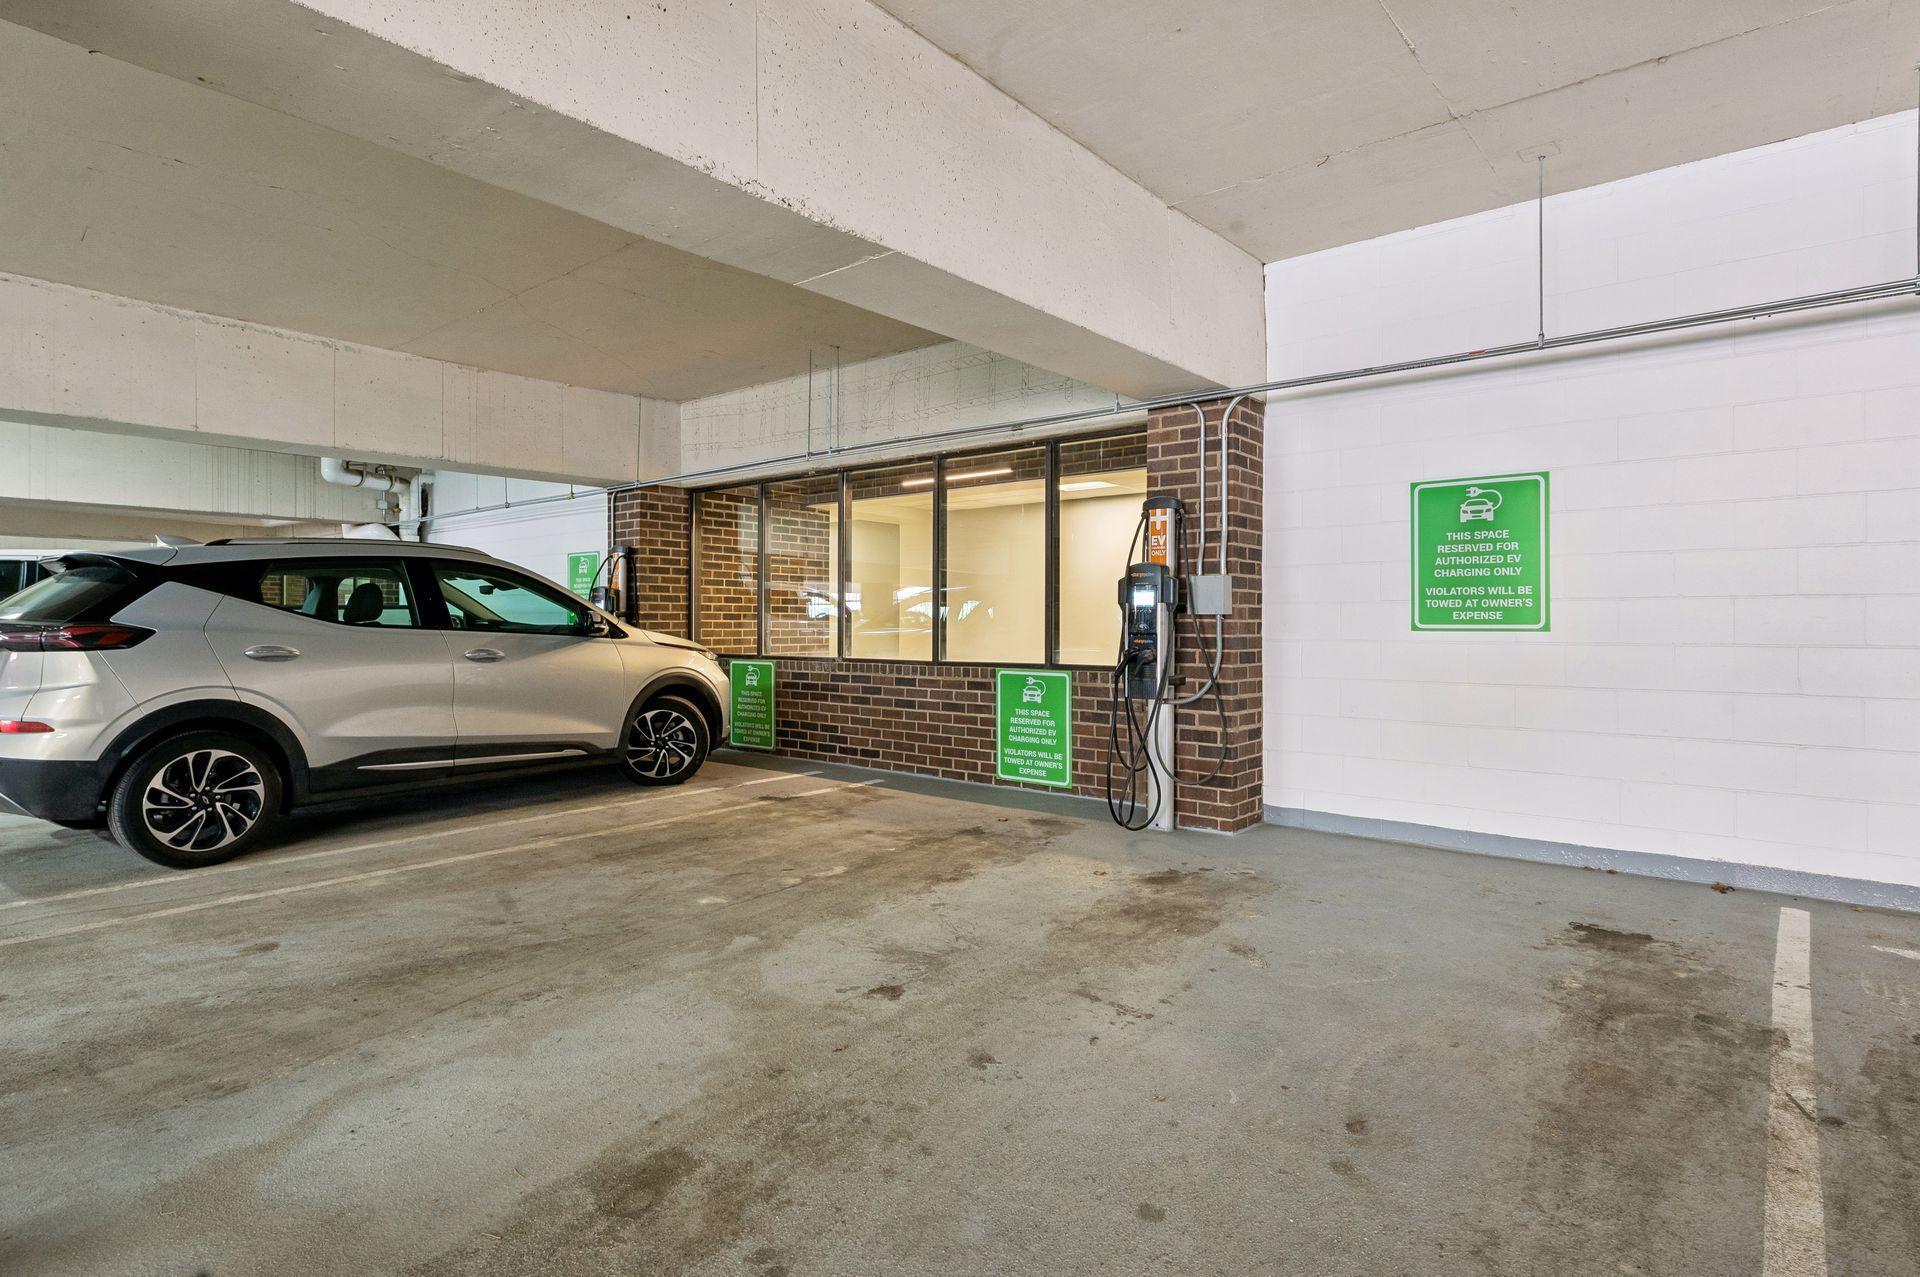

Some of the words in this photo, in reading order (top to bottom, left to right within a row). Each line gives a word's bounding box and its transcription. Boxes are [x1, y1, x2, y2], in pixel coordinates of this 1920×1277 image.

[1446, 531, 1471, 540] THIS
[1474, 530, 1510, 540] SPACE
[1152, 535, 1166, 546] EV
[1438, 542, 1492, 553] RESERVED
[1497, 542, 1519, 550] FOR
[1436, 554, 1504, 566] AUTHORIZED
[1507, 554, 1522, 562] EV
[1434, 568, 1490, 578] CHARGING
[1494, 567, 1522, 576] ONLY
[1426, 586, 1485, 596] VIOLATORS
[1488, 586, 1514, 594] WILL
[1518, 586, 1532, 594] BE
[1426, 599, 1462, 608] TOWED
[1466, 599, 1478, 608] AT
[1482, 598, 1533, 608] OWNER'S
[1452, 611, 1502, 620] EXPENSE
[1030, 710, 1050, 718] SPACE
[1010, 717, 1041, 726] RESERVED
[1010, 726, 1047, 736] AUTHORIZED
[1008, 734, 1040, 744] CHARGING
[1041, 738, 1057, 746] ONLY
[1004, 748, 1036, 758] VIOLATORS
[1038, 752, 1052, 760] WILL
[1004, 756, 1024, 765] TOWED
[1034, 760, 1062, 770] OWNER'S
[1019, 768, 1046, 776] EXPENSE
